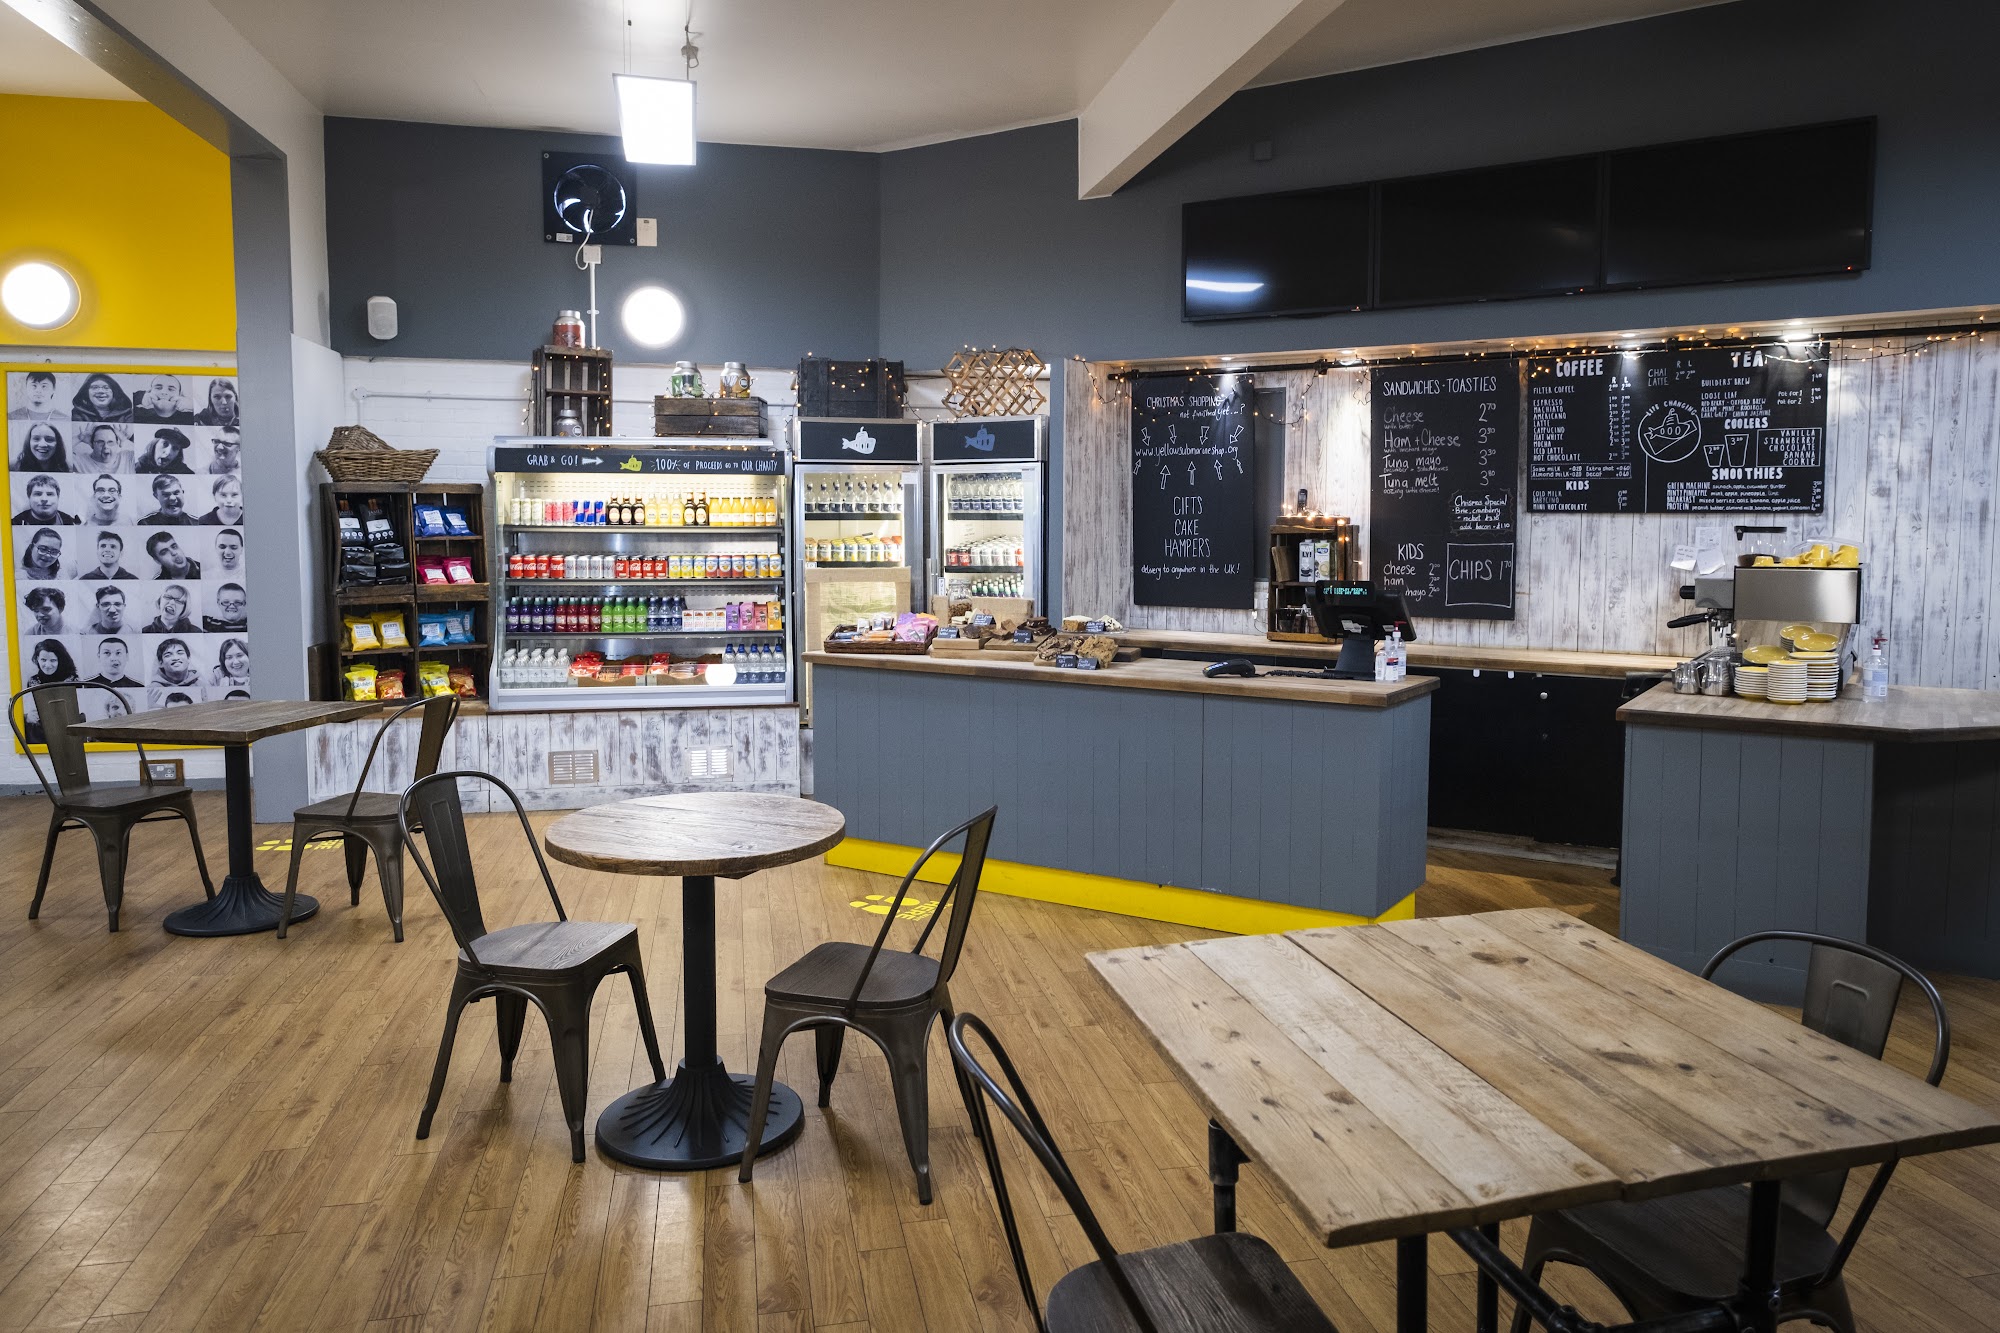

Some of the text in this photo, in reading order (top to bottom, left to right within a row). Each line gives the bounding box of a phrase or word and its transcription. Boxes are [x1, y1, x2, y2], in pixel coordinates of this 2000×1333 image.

[1731, 351, 1763, 368] TEA
[1556, 358, 1603, 378] COFFEE
[1648, 368, 1666, 377] CHAI
[1383, 376, 1497, 396] SANDWICHES TOASTIES
[1648, 377, 1669, 386] LATTE
[1734, 377, 1750, 385] BREW
[1533, 385, 1575, 394] FILTER COFFEE
[1701, 392, 1720, 400] LOOSE
[1724, 391, 1737, 399] LEAF
[1146, 395, 1221, 408] CHRISTMAS SHOPPING
[1646, 400, 1697, 416] LIFE CHANGING
[1180, 410, 1189, 418] not
[1192, 409, 1216, 420] finished
[1384, 406, 1424, 424] Cheese
[1533, 412, 1567, 420] AMERICANO
[1533, 419, 1550, 427] LATTE
[1724, 417, 1768, 429] COOLERS
[1384, 430, 1411, 448] Ham
[1421, 428, 1461, 447] Cheese
[1533, 440, 1551, 448] MOCHA
[1764, 437, 1815, 445] STRAWBERRY
[1769, 444, 1815, 452] CHOCOLATE
[527, 454, 578, 466] GRAB & GO!
[1784, 451, 1815, 459] BANANA
[656, 458, 677, 470] 100%
[696, 460, 723, 470] PROCEEDS
[741, 460, 752, 470] OUR
[756, 460, 778, 472] CHARITY
[1382, 454, 1409, 468] Tuna
[1416, 456, 1441, 470] mayo
[1712, 468, 1783, 480] SMOOTHIES
[1379, 473, 1408, 488] Tuna
[1415, 473, 1439, 488] melt
[1566, 480, 1589, 491] KIDS
[1384, 488, 1404, 499] oozing
[1173, 496, 1203, 516] GIFTS
[1484, 494, 1508, 508] Special
[1667, 502, 1689, 510] PROTEIN
[1174, 519, 1199, 536] CAKE
[1460, 522, 1491, 530] add bacon
[1164, 538, 1210, 558] HAMPERS
[1398, 543, 1424, 561] KIDS
[1141, 563, 1240, 580] delivery to anywhere in the UK!
[1383, 560, 1416, 575] cheese
[1449, 559, 1492, 580] CHIPS
[1384, 576, 1404, 586] ham
[1405, 585, 1426, 602] mayo
